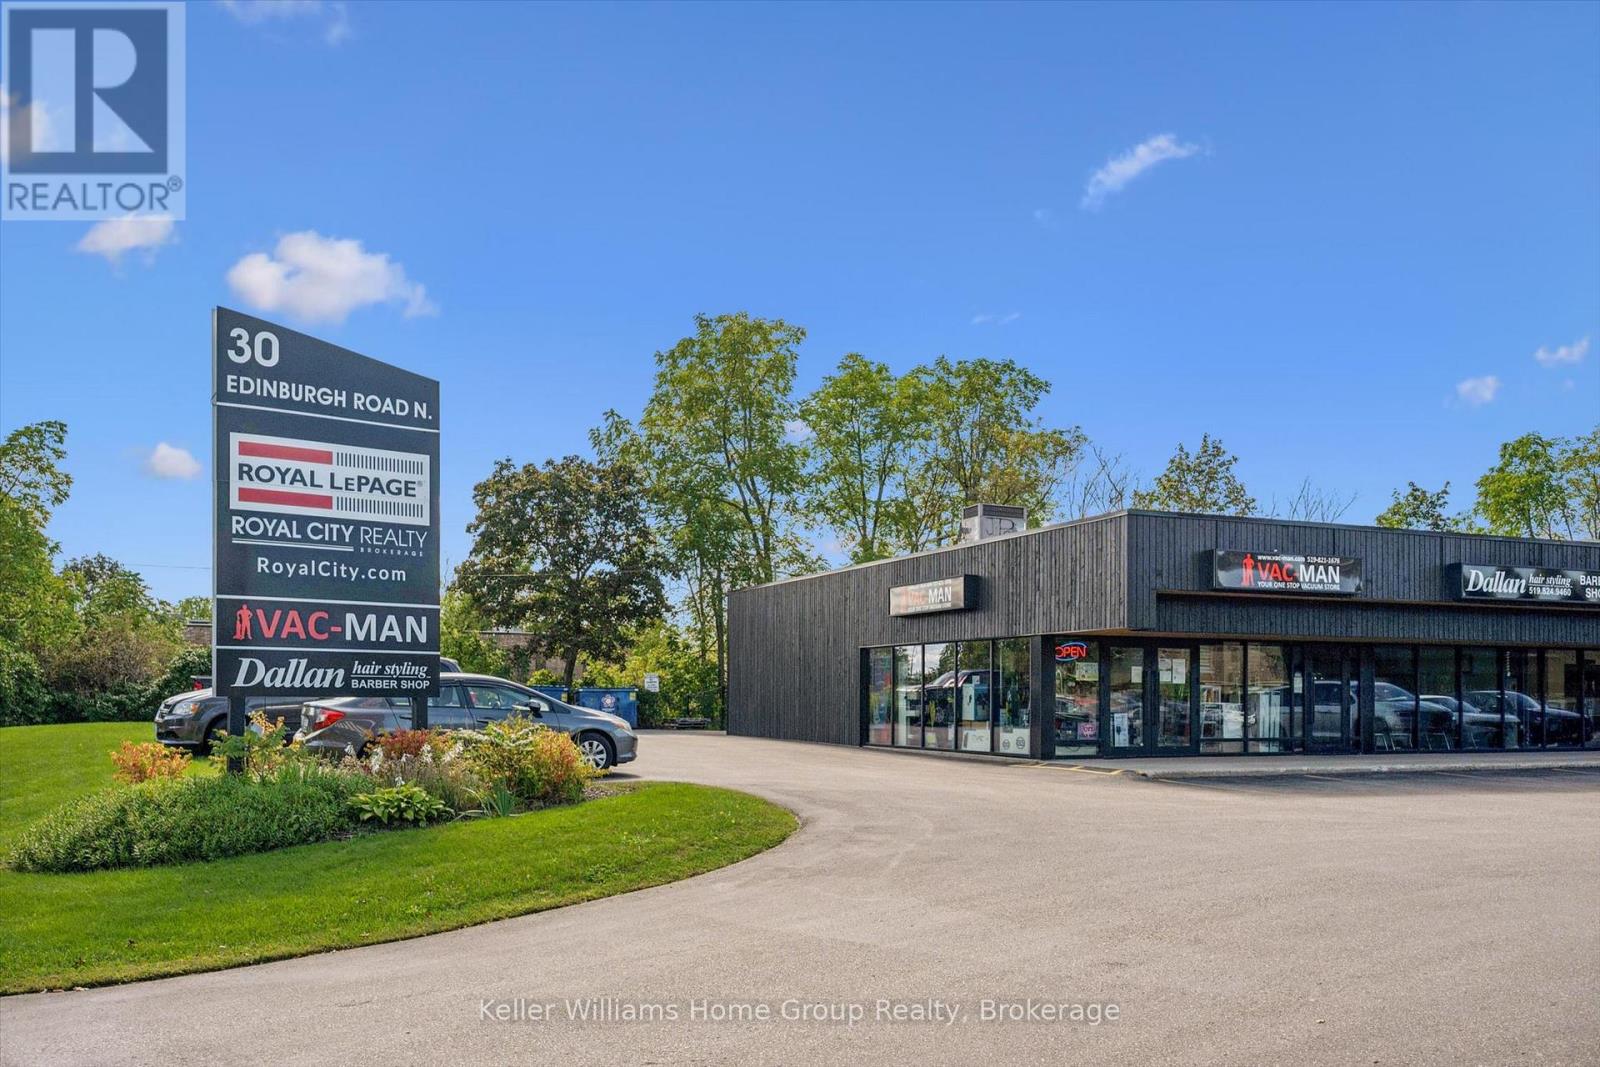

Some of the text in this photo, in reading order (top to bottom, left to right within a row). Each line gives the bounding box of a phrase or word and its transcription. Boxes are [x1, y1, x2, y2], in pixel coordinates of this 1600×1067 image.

[227, 327, 279, 368] 30
[226, 374, 433, 420] EDINBURGH ROAD N.
[238, 463, 323, 488] ROYAL
[232, 516, 428, 548] ROYAL CITY REALTY
[360, 547, 423, 557] BROKERAGE
[257, 557, 407, 582] RoyalCity.com
[1257, 562, 1340, 583] VAC-MAN
[1529, 574, 1571, 588] hair styling
[1580, 575, 1600, 586] BAR
[1258, 581, 1273, 589] YOUR
[1466, 569, 1526, 594] Dallan
[256, 608, 427, 643] VAC-MAN
[1055, 646, 1087, 658] OPEN
[230, 657, 345, 688] Dallan
[353, 661, 428, 678] hair styling
[352, 679, 430, 689] BARBER SHOP
